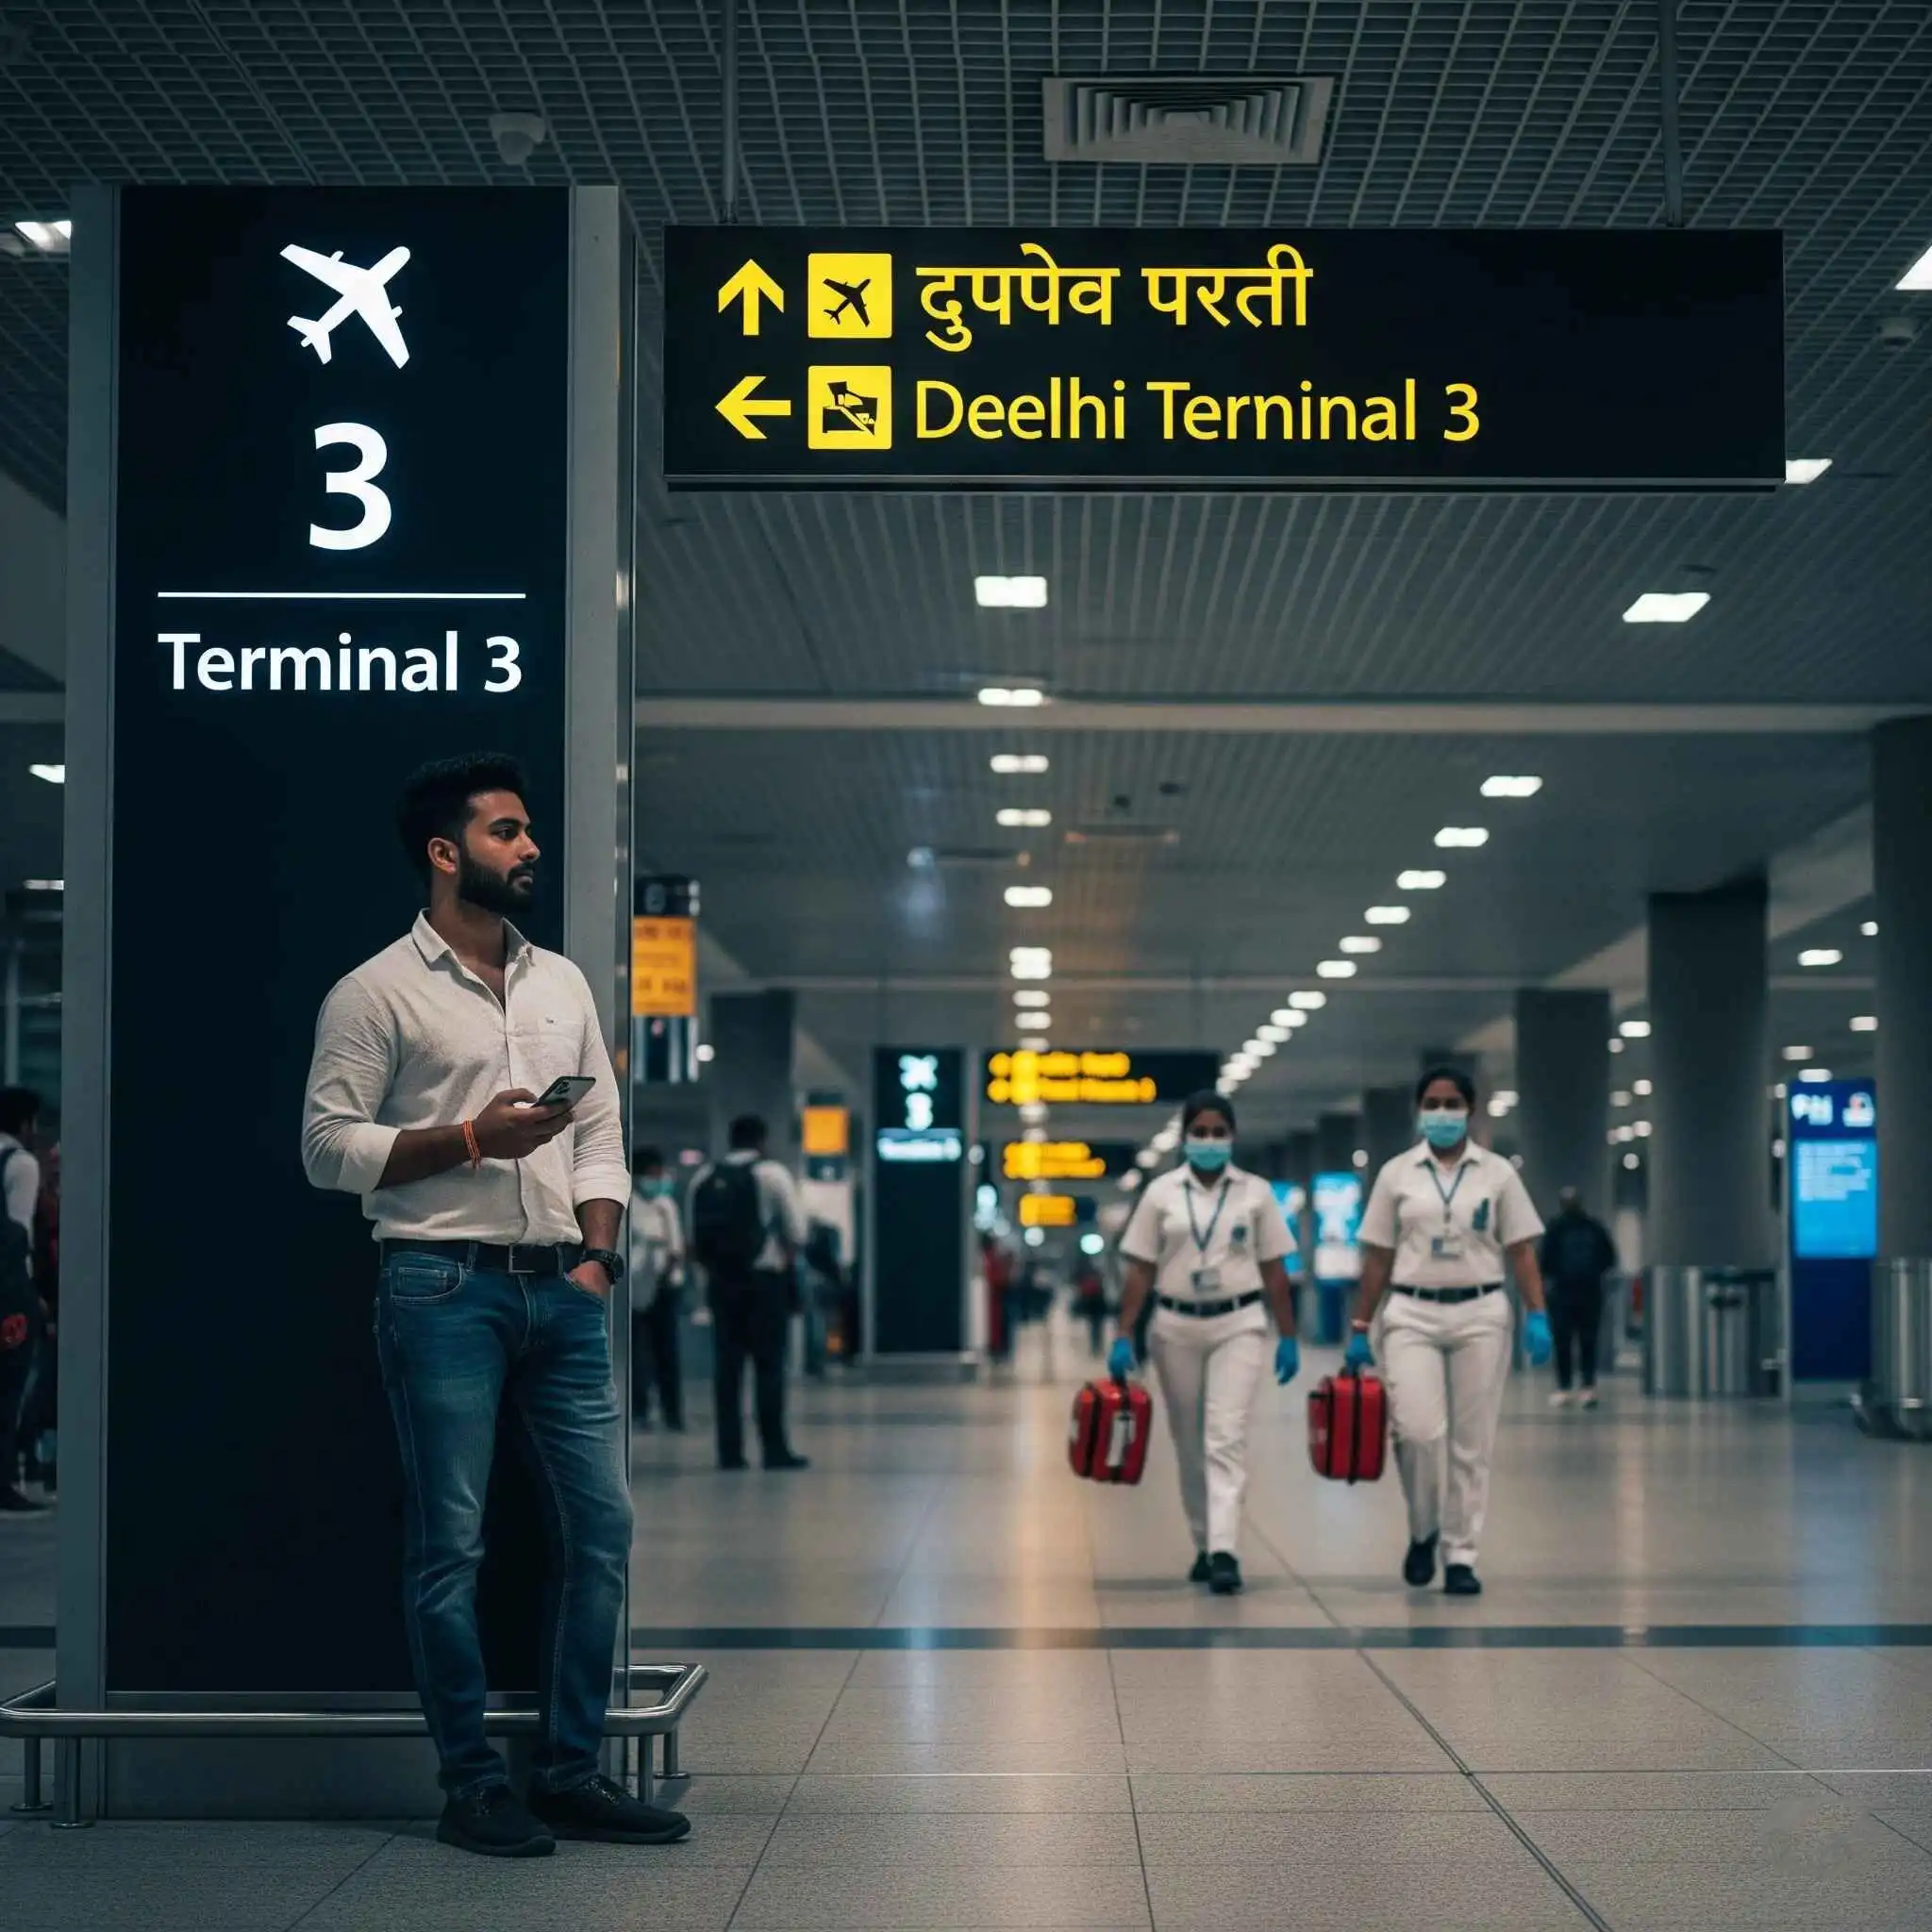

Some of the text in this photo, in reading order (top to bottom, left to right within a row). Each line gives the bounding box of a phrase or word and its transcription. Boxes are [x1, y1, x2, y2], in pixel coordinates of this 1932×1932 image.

[1141, 244, 1313, 327] परती
[917, 377, 1479, 441] Deelhi Terninal 3
[309, 423, 391, 550] 3
[158, 631, 522, 692] Terminal 3
